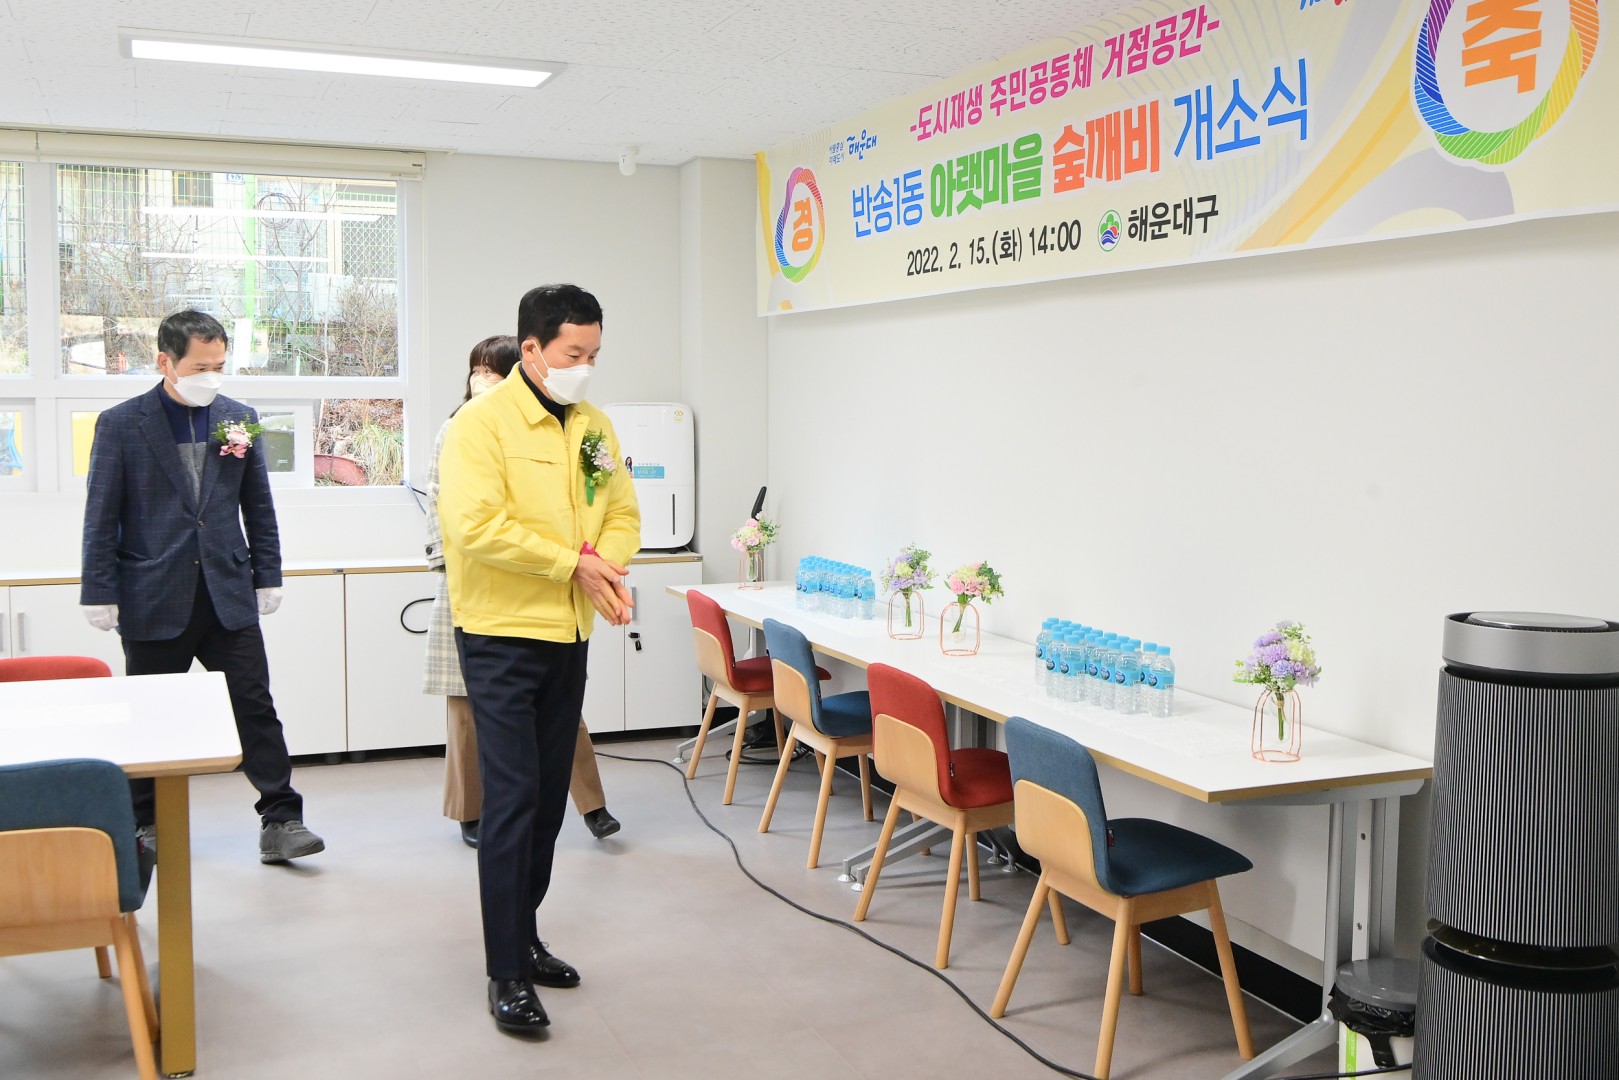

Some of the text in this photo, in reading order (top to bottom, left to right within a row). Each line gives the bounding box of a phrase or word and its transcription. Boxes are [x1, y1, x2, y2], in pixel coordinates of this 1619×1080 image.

[910, 5, 1220, 142] -도시재생 주민공동체 거점공간-
[847, 129, 877, 160] 해운대
[852, 58, 1308, 238] 반송1동 아랫마을 숲깨비 개소식
[791, 197, 813, 252] 경
[1127, 194, 1219, 244] 해운대구
[907, 219, 1082, 277] 2022. 2. 15.(화) 14:00
